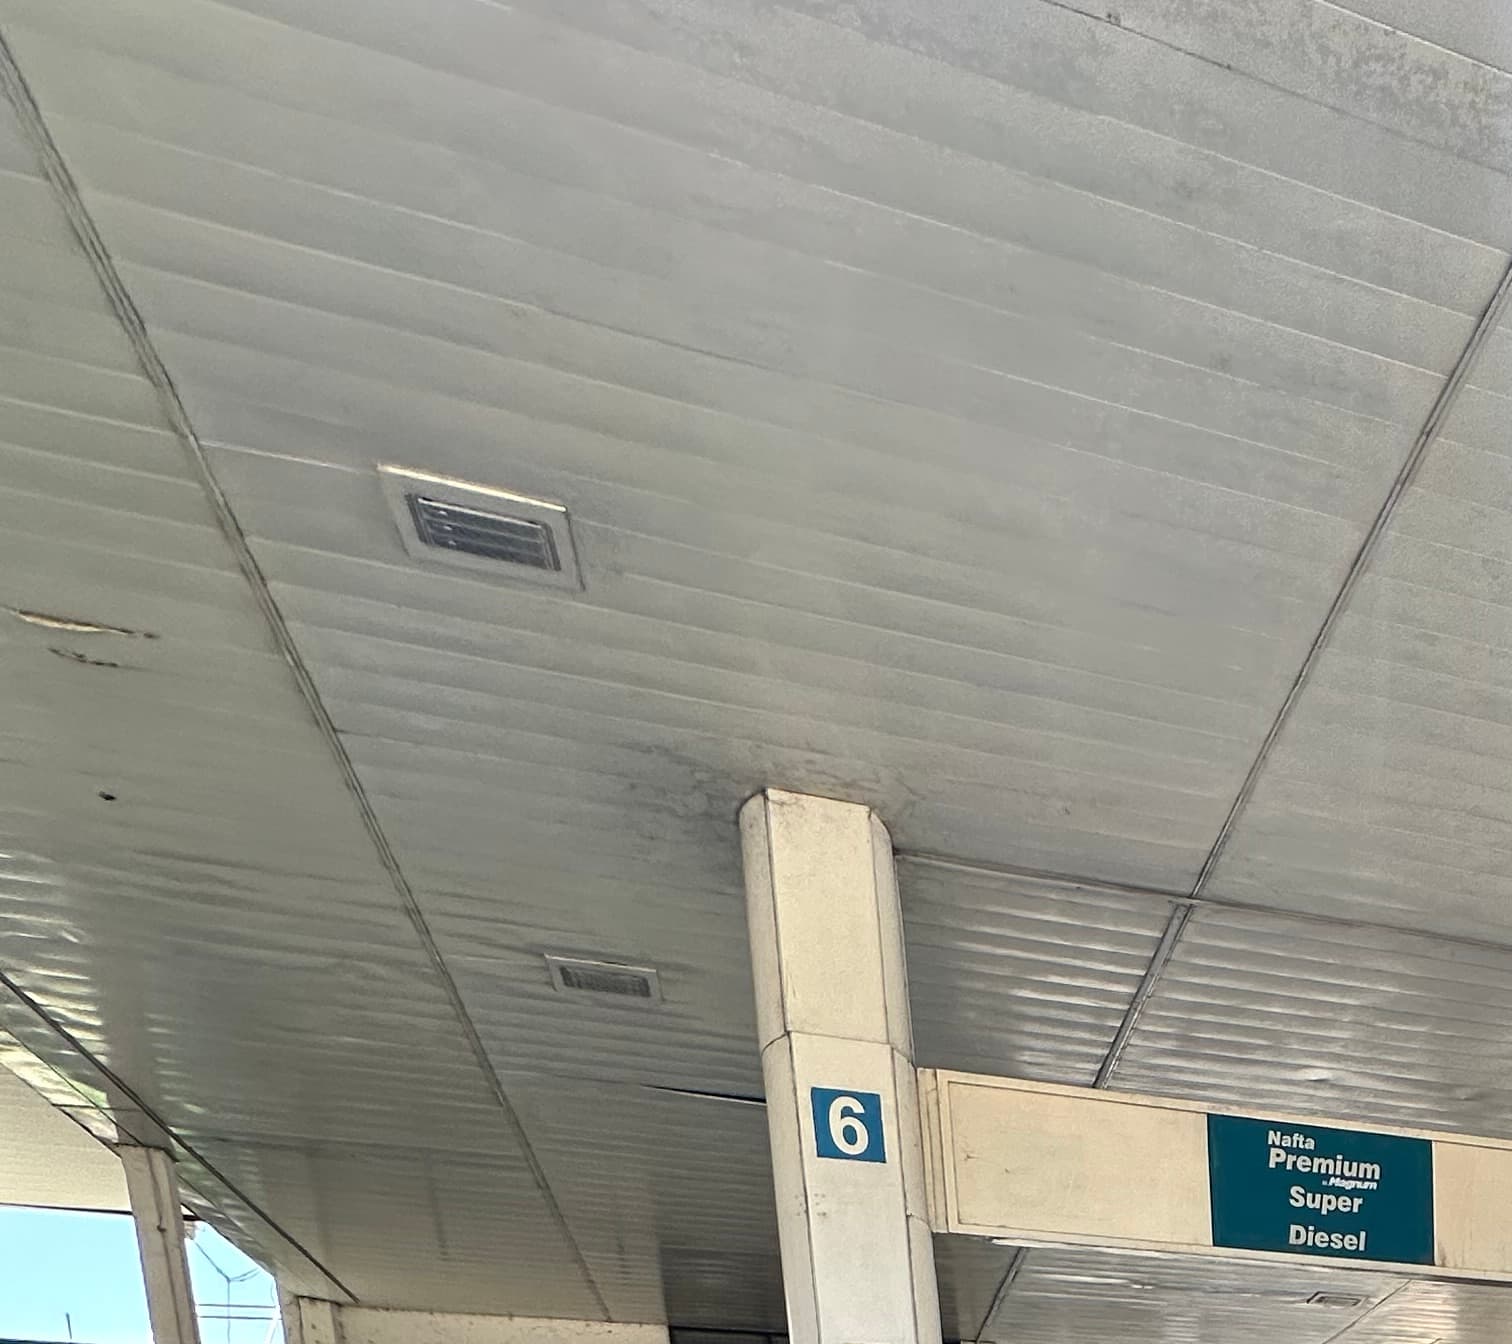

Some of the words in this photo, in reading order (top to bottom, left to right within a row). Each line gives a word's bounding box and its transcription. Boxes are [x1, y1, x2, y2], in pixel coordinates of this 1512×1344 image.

[828, 1095, 870, 1156] 6
[1267, 1130, 1316, 1150] Nafta
[1268, 1147, 1381, 1180] Premium
[1328, 1176, 1378, 1191] Magnum
[1288, 1185, 1364, 1216] Super
[1288, 1223, 1366, 1251] Diesel
